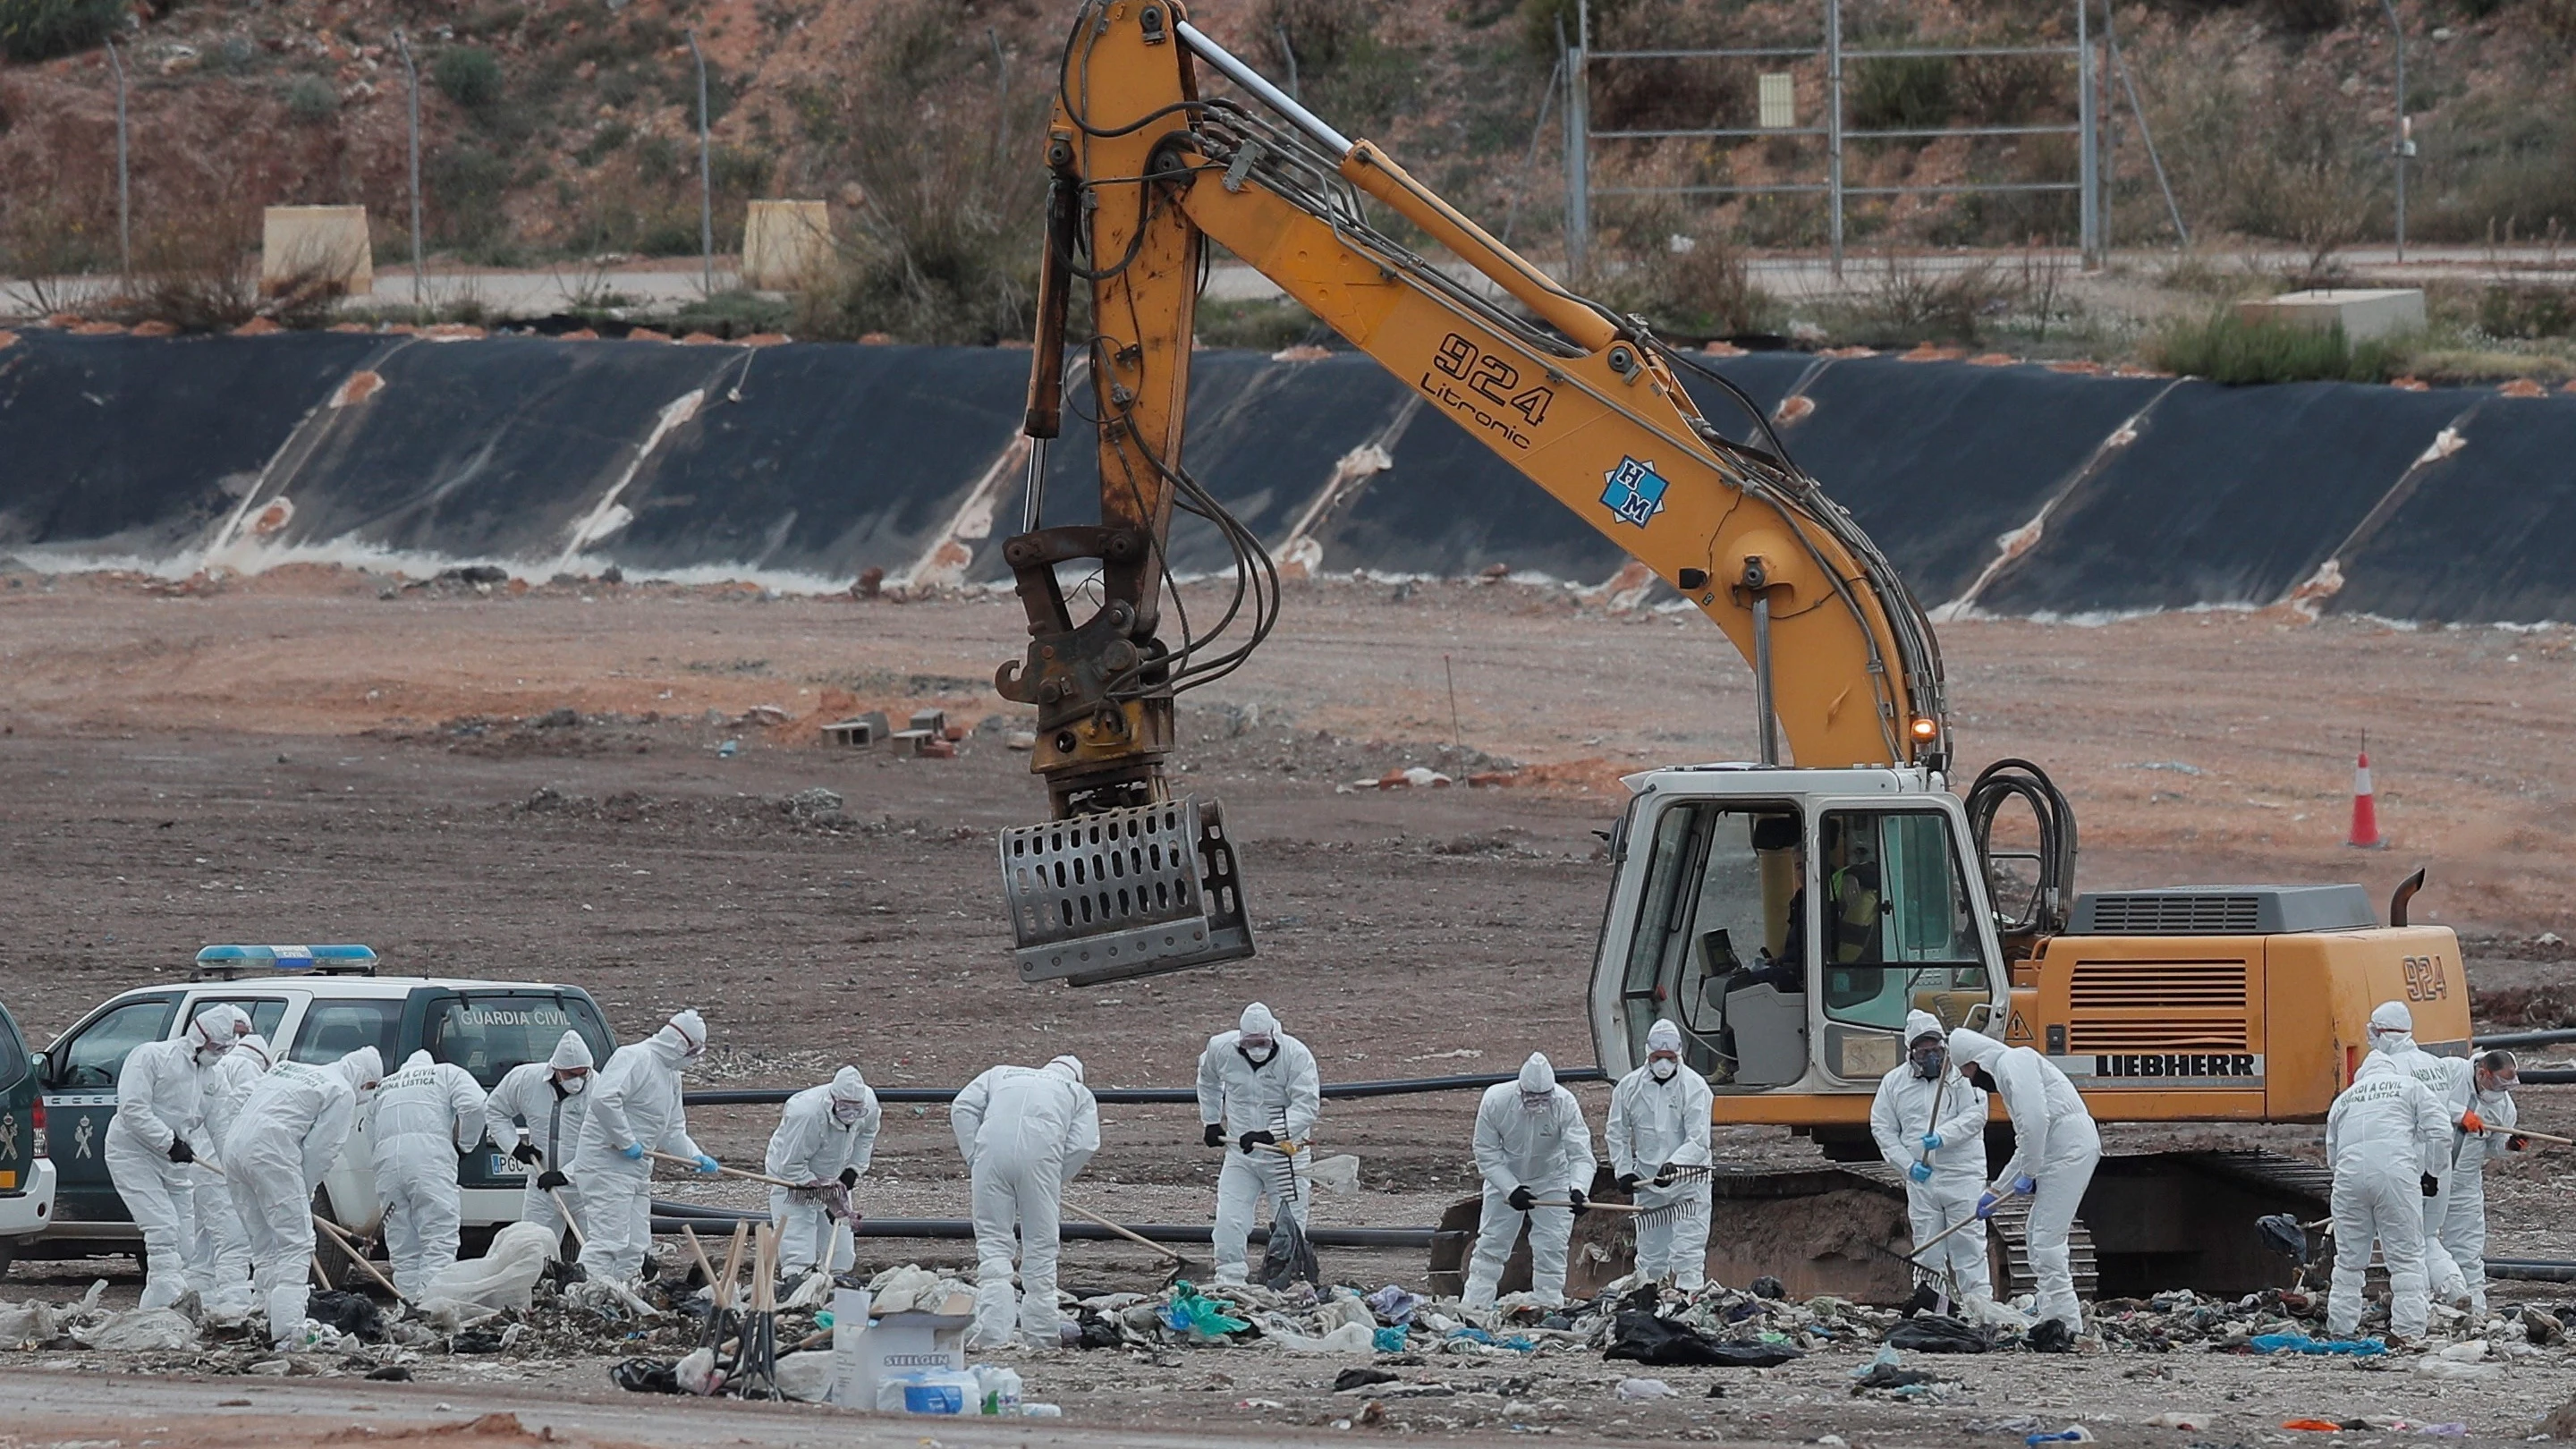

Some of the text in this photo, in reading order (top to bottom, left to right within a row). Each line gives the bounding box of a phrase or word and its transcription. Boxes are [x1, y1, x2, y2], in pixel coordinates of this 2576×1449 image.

[1434, 333, 1554, 427] 924
[1420, 372, 1530, 449] Litronic
[1616, 460, 1646, 490] H
[1620, 491, 1651, 523] M
[2402, 955, 2447, 1001] 924
[461, 1011, 572, 1026] GUARDIA CIVIL
[412, 1067, 436, 1078] CIVIL
[2096, 1054, 2255, 1077] LIEBHERR
[2379, 1080, 2402, 1091] CIVIL
